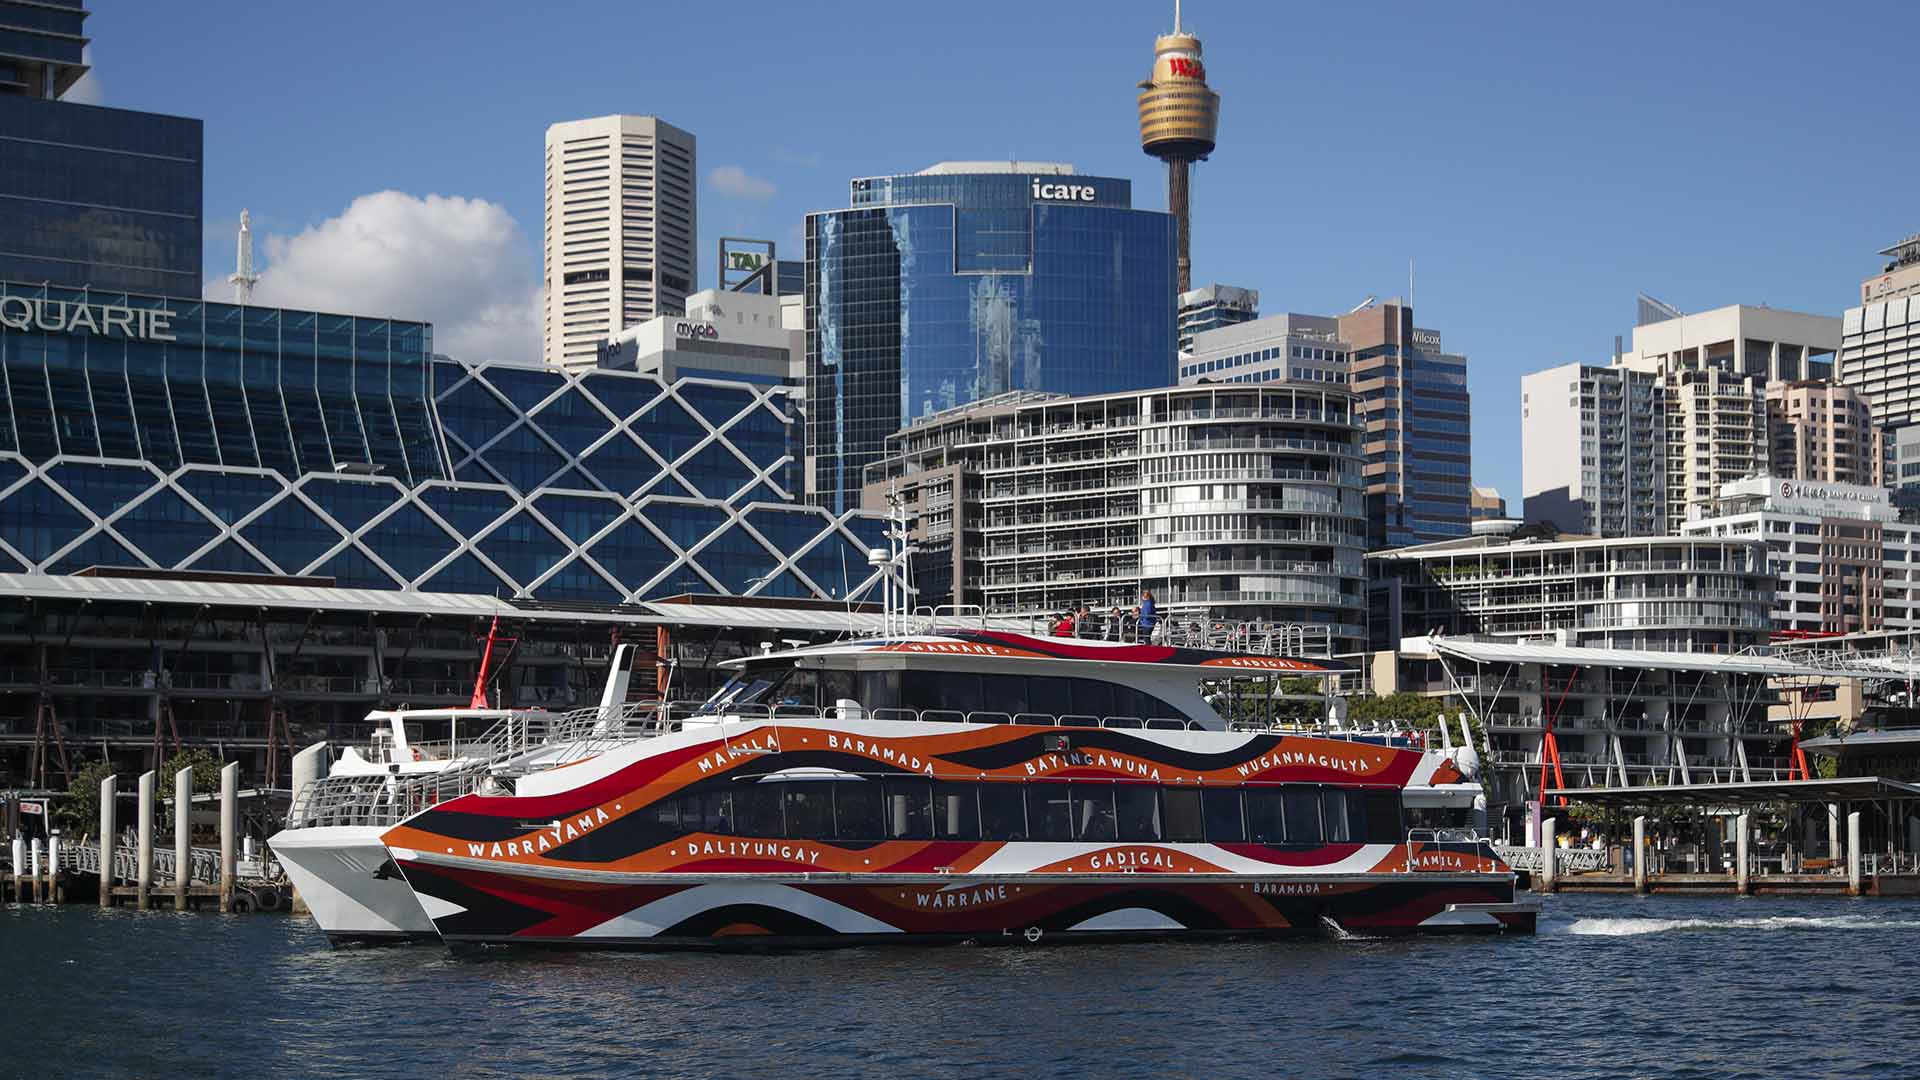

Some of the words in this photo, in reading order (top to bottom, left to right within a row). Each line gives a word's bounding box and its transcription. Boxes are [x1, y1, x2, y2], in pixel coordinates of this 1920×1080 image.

[1032, 177, 1095, 201] icare
[0, 295, 177, 342] QUARIE
[676, 321, 715, 338] myob
[911, 644, 997, 655] WARRANE
[1231, 659, 1296, 668] GADIGAL
[697, 734, 777, 773] MAMILA
[828, 734, 934, 778] BARAMADA
[1237, 751, 1369, 776] WUGANMAGULYA
[1024, 753, 1161, 781] BAYINGAWUNA
[468, 808, 609, 857] WARRAYAMA
[688, 841, 820, 864] DALIYUNGAY
[1090, 851, 1174, 869] GADIGAL
[1411, 855, 1462, 868] MAMILA
[916, 885, 1008, 908] WARRANE
[1253, 883, 1320, 894] BARAMADA
